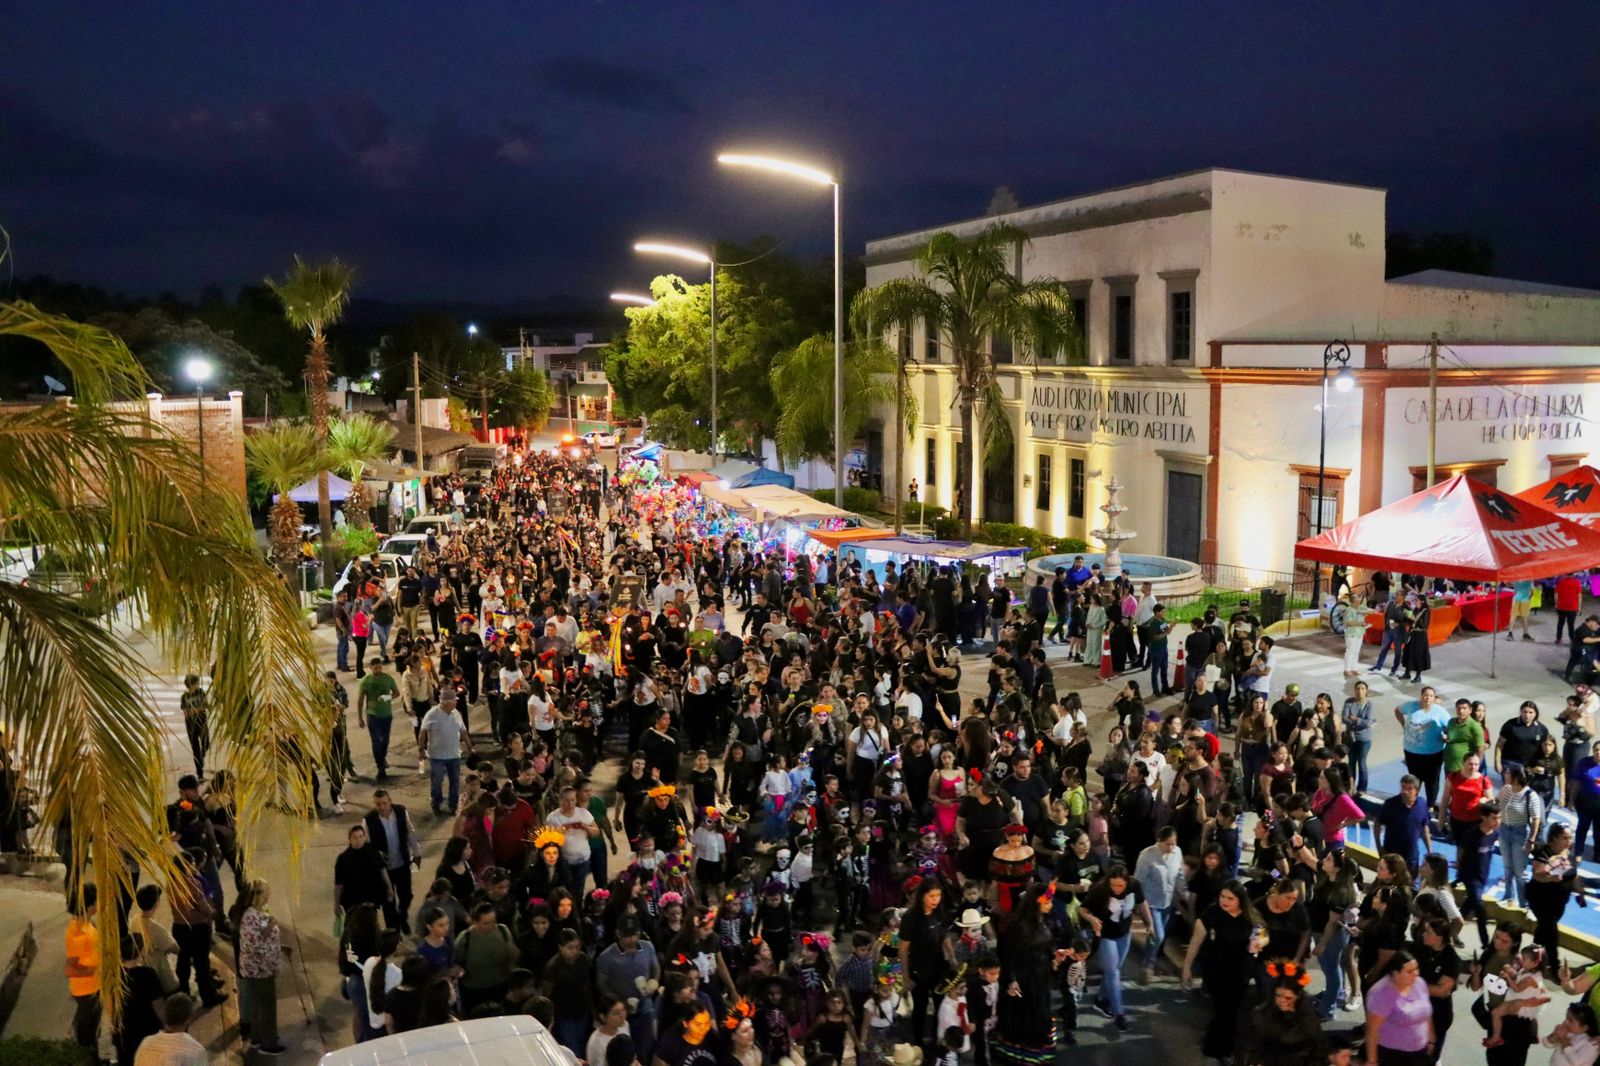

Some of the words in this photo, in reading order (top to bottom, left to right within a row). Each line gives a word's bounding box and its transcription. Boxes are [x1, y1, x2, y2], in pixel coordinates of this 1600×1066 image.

[1031, 386, 1103, 410] AUDITORIO
[1107, 389, 1191, 417] MUNICIPAL
[1404, 397, 1454, 425] CASA
[1458, 397, 1480, 421] DE
[1485, 395, 1509, 420] LA
[1513, 393, 1584, 418] CULTURA
[1042, 412, 1086, 432] HECTOR
[1090, 416, 1139, 437] CASTRO
[1144, 421, 1196, 443] ABITIA
[1490, 522, 1578, 554] TECATE
